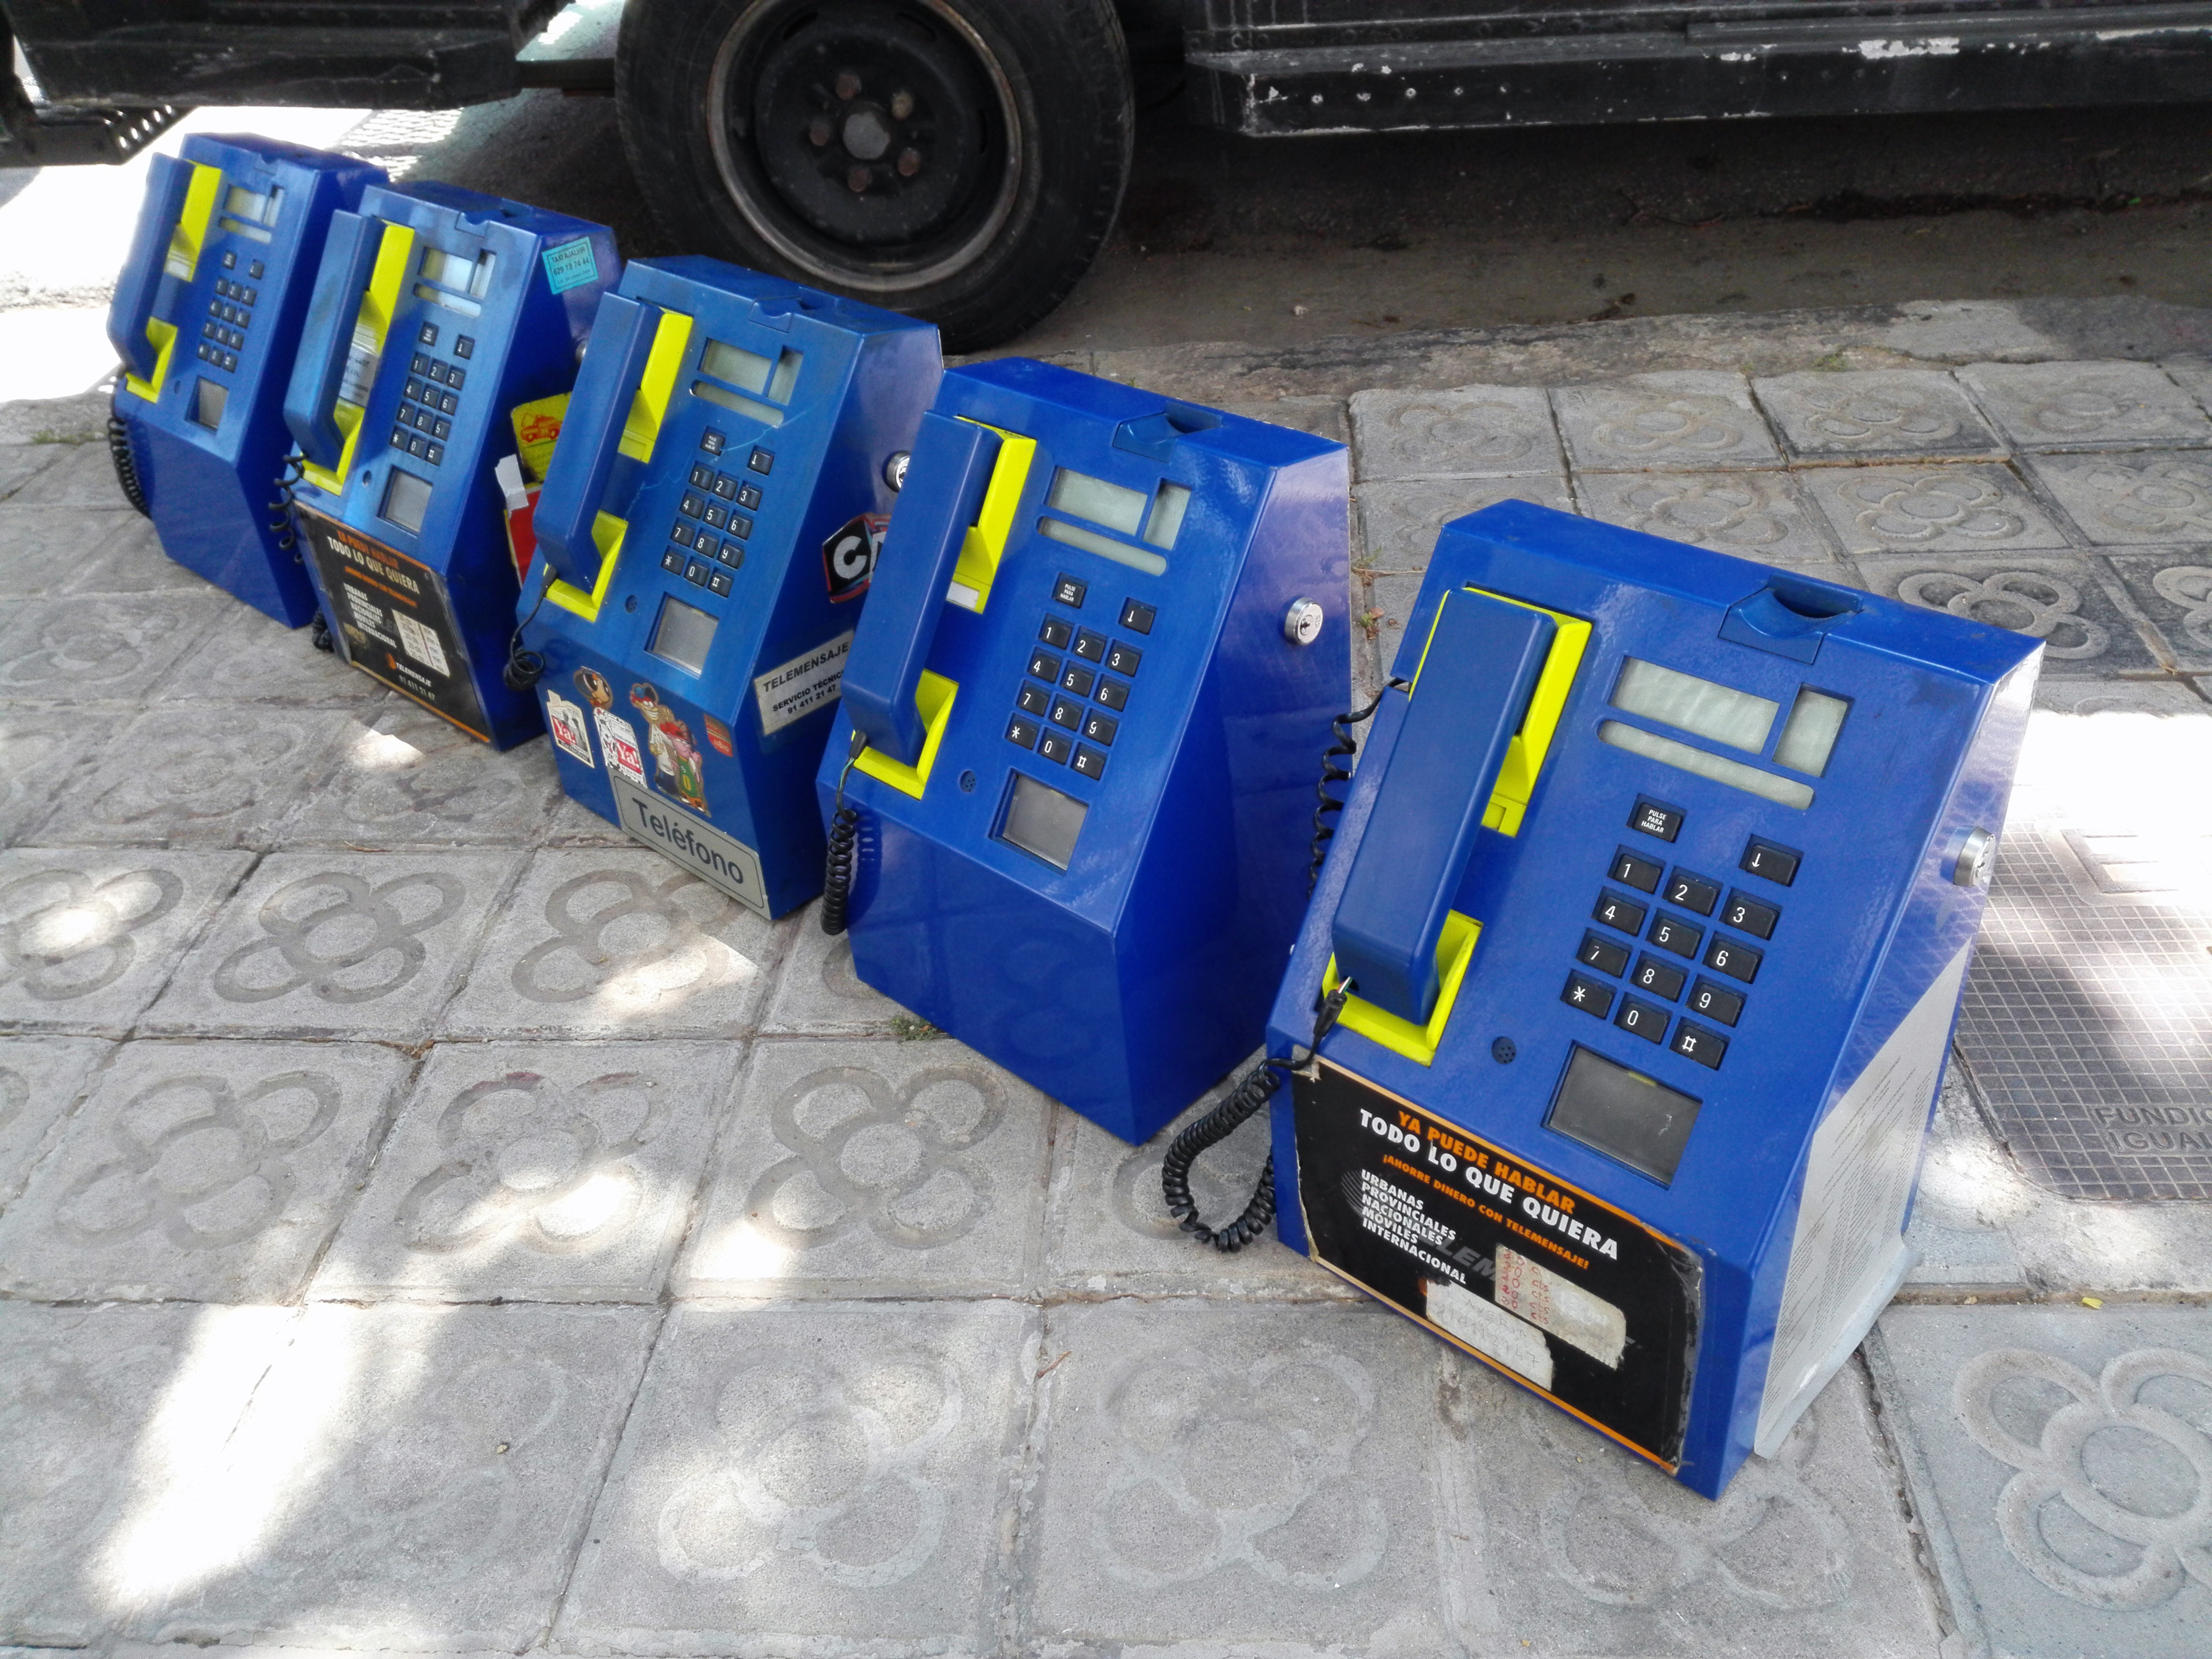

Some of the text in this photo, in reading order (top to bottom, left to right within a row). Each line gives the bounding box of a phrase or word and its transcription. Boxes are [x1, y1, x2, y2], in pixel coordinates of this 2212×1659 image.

[694, 471, 747, 501] 1 2 3
[683, 500, 736, 531] 4 5 6
[675, 527, 681, 538] 7
[698, 538, 705, 548] 8
[327, 536, 351, 558] TODO
[353, 549, 364, 565] LO
[366, 556, 384, 575] QUE
[386, 567, 420, 594] QUIERA
[689, 566, 695, 576] 0
[1046, 627, 1120, 666] 1 2 3
[396, 662, 431, 687] TELEMENSAJE
[764, 642, 849, 692] TELEMENSAJE
[1033, 660, 1109, 701] 4 5 6
[773, 670, 843, 711] SERVICIO TÉCNIC
[788, 705, 797, 714] 91
[800, 697, 813, 707] 411
[827, 684, 836, 693] 47
[1024, 693, 1031, 705] 7
[1055, 707, 1063, 720] 8
[553, 717, 576, 743] Ya!
[1044, 741, 1052, 753] 0
[616, 742, 639, 767] Ya!
[1641, 820, 1664, 833] HABLAR
[1647, 816, 1663, 826] PARA
[1649, 809, 1666, 820] PULSE
[632, 798, 743, 884] Teléfono
[1623, 864, 1745, 923] 1 2 3
[1605, 906, 1729, 966] 4 5 6
[1643, 968, 1655, 984] 8
[1699, 993, 1711, 1008] 9
[1627, 1010, 1639, 1026] 0
[1399, 1111, 1575, 1214] YA PUEDE HABLAR
[1360, 1109, 1420, 1152] TODO
[1428, 1144, 1457, 1171] LO
[1466, 1167, 1514, 1203] QUE
[1523, 1197, 1618, 1260] QUIERA
[1362, 1169, 1423, 1210] URBANAS
[1362, 1182, 1456, 1240] PROVINCIALES
[1362, 1194, 1443, 1245] NACIONALES
[1362, 1206, 1418, 1243] MÓVILES
[1383, 1154, 1430, 1184] ¡AHORRE
[1434, 1179, 1475, 1207] DINERO
[1479, 1205, 1503, 1222] CON
[1506, 1218, 1589, 1269] TELEMENSAJE!
[1362, 1218, 1467, 1284] INTERNACIONAL
